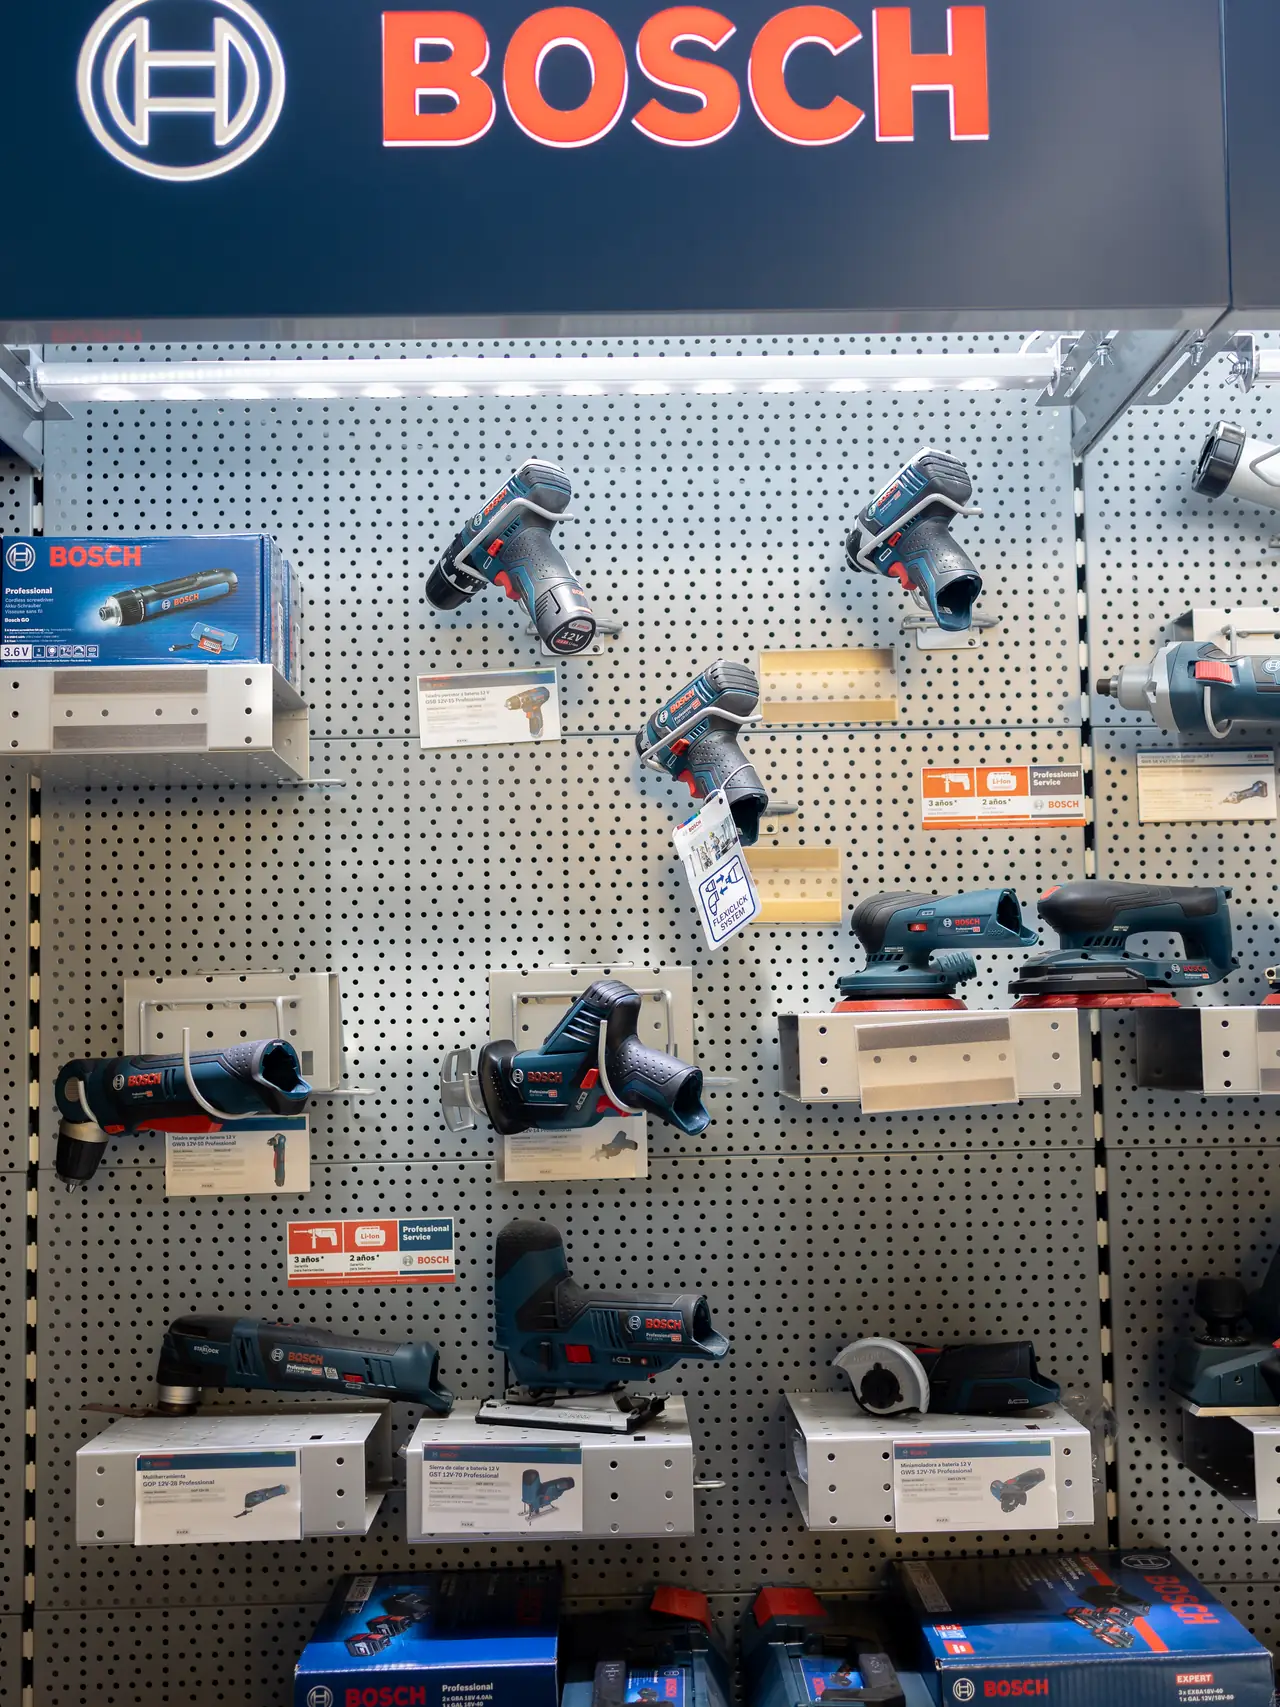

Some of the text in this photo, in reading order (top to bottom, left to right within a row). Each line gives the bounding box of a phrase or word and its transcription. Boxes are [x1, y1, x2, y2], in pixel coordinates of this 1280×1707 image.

[382, 6, 990, 148] BOSCH
[50, 546, 142, 567] BOSCH
[5, 587, 53, 595] Professional
[173, 593, 199, 607] BOSCH
[561, 631, 584, 642] 12V
[4, 647, 20, 657] 3.6
[22, 647, 29, 657] V
[670, 689, 695, 713] BOSCH
[1033, 770, 1079, 779] Professional
[1048, 800, 1079, 808] BOSCH
[688, 819, 702, 833] BOSCH
[712, 894, 749, 927] FLEXICLICK
[720, 907, 746, 931] SYSTEM
[954, 918, 980, 926] BOSCH
[128, 1072, 162, 1087] BOSCH
[528, 1072, 562, 1083] BOSCH
[402, 1225, 450, 1233] Professional
[418, 1256, 449, 1264] BOSCH
[645, 1318, 682, 1330] BOSCH
[288, 1352, 324, 1364] BOSCH
[1143, 1575, 1220, 1624] BOSCH
[1177, 1674, 1212, 1683] EXPERT
[442, 1682, 494, 1692] Professional
[984, 1679, 1049, 1698] BOSCH
[345, 1686, 426, 1707] BOSCH
